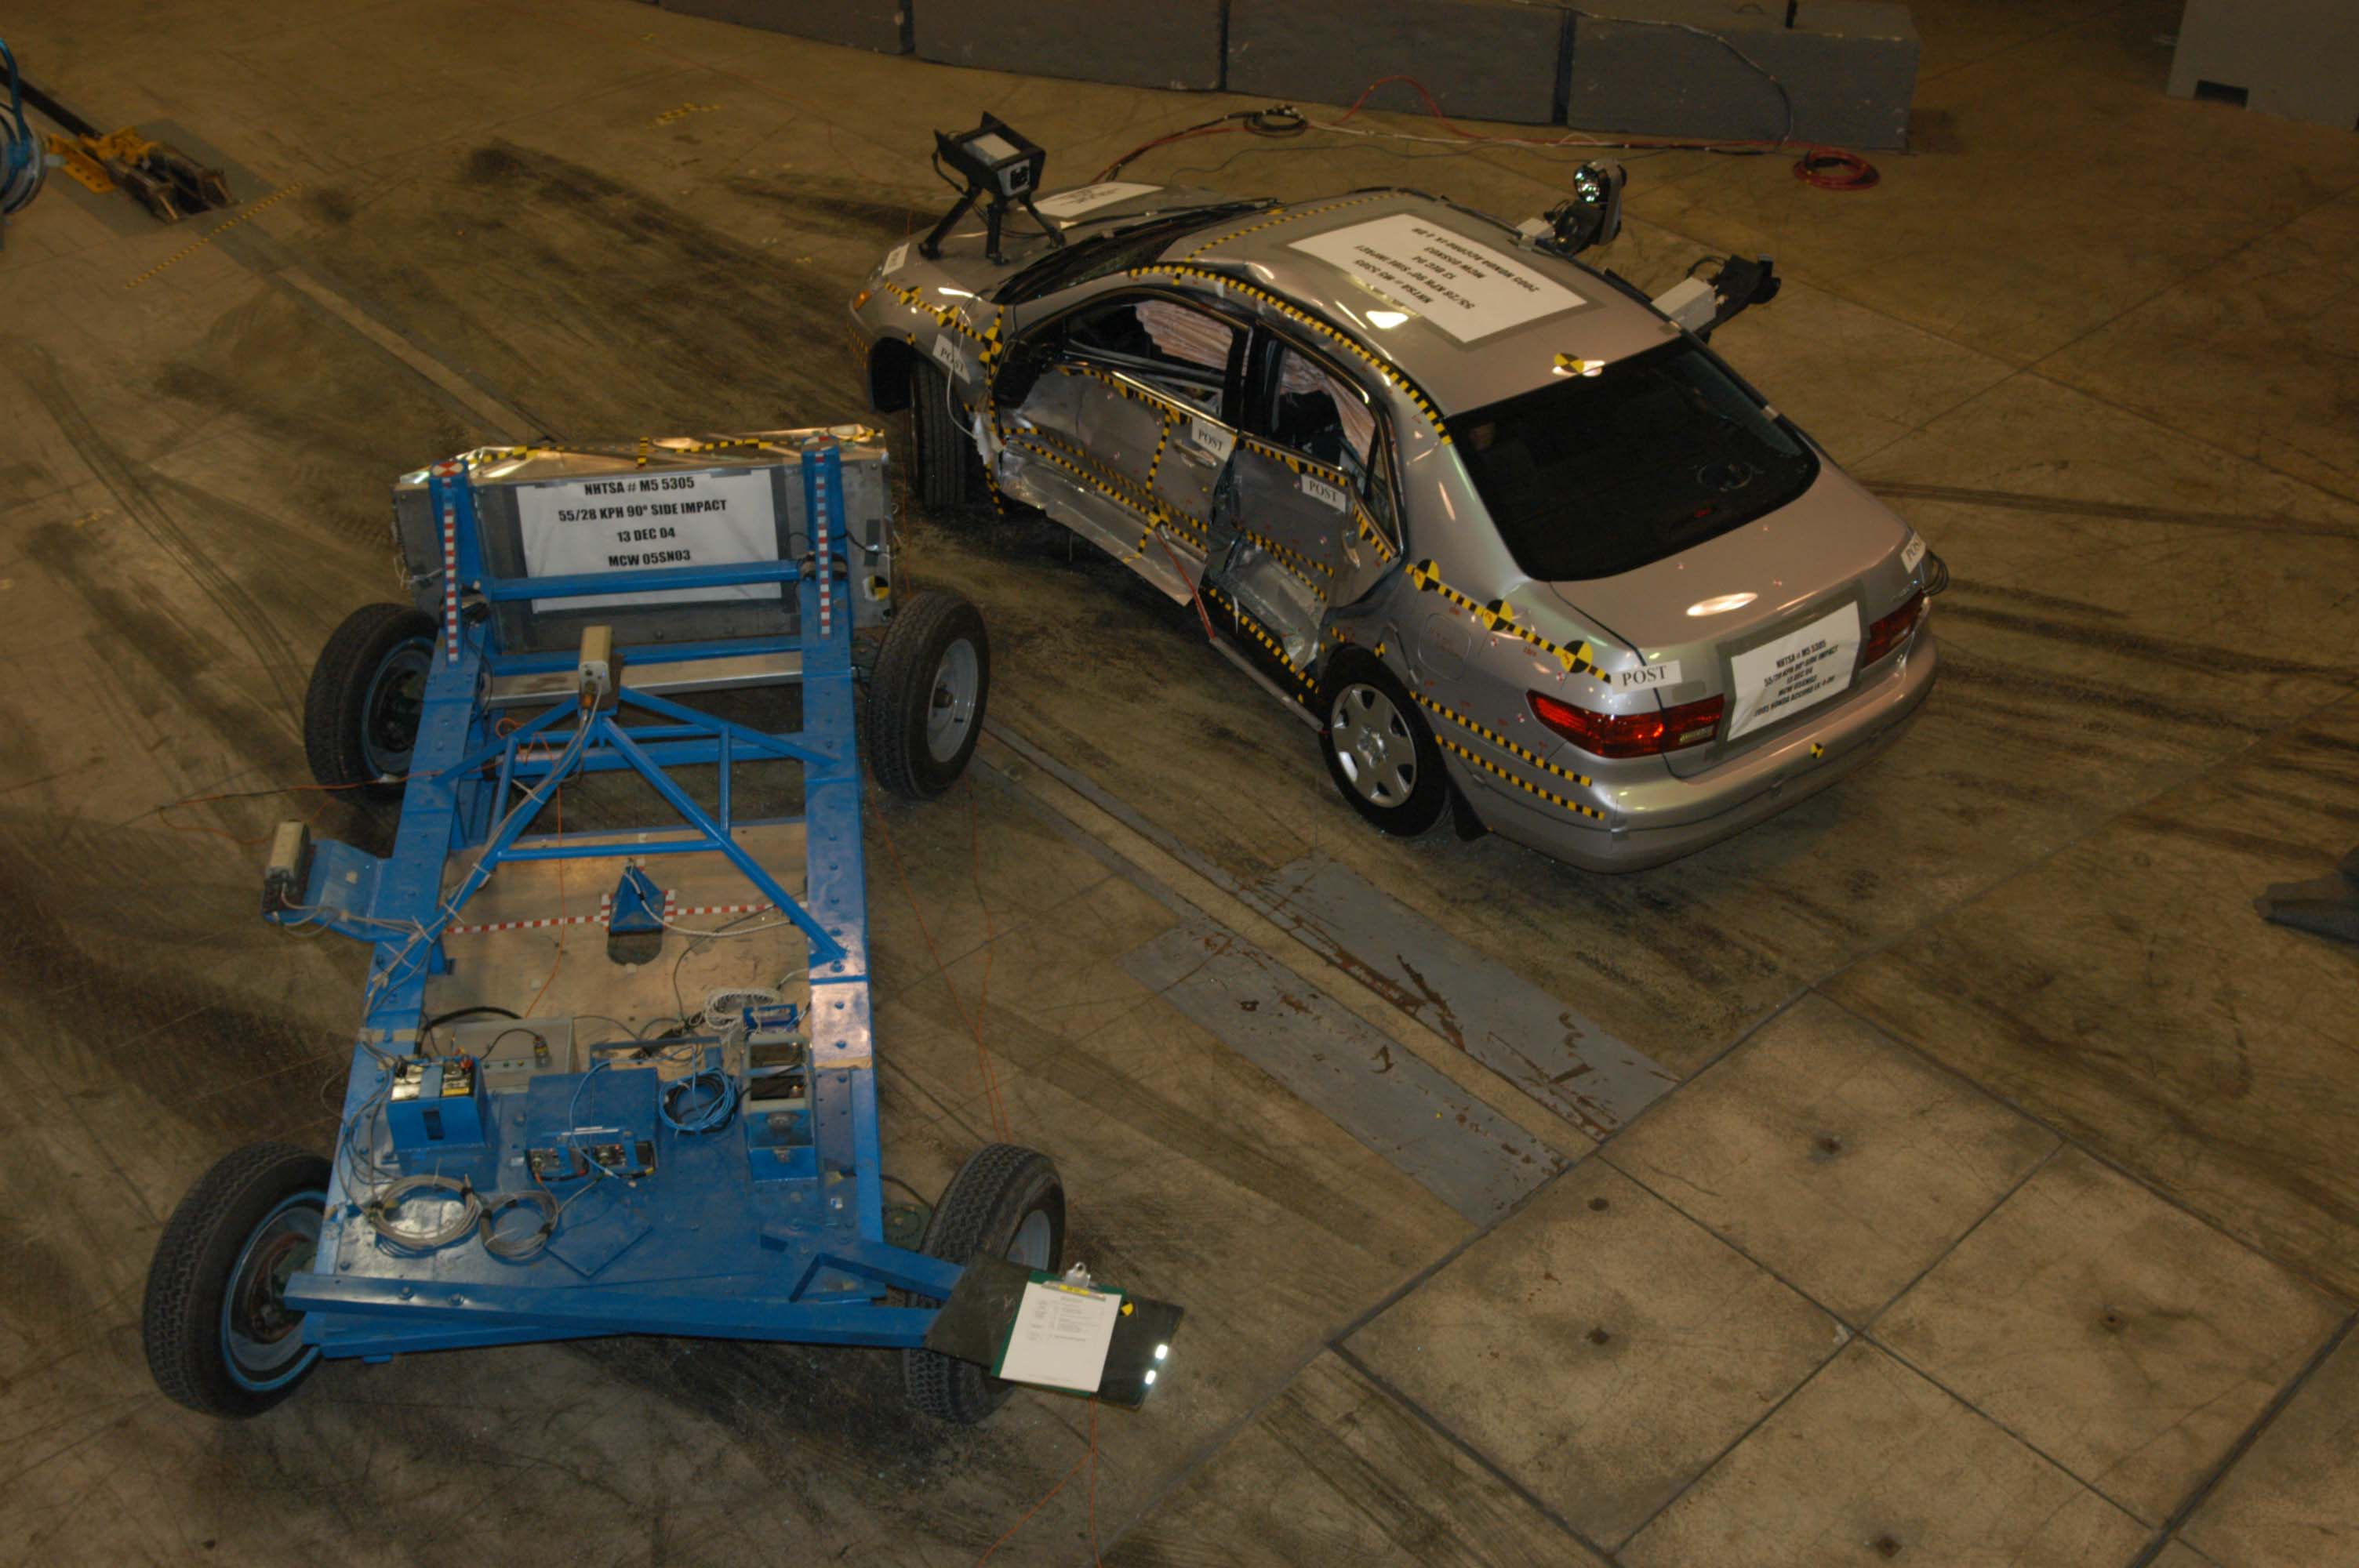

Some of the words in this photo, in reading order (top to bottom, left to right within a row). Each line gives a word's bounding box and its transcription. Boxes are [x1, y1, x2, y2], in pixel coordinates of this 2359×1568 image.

[1198, 428, 1224, 451] POST
[584, 481, 625, 495] NHTSA
[627, 483, 637, 492] #
[639, 480, 659, 492] M5
[661, 477, 695, 490] 5305
[1309, 480, 1338, 503] POST
[558, 508, 597, 522] 55/28
[600, 507, 624, 521] KPH
[651, 503, 678, 516] SIDE
[681, 499, 727, 514] IMPACT
[616, 530, 631, 543] 13
[634, 528, 657, 541] DEC
[660, 526, 676, 539] 04
[608, 554, 640, 568] MCW
[642, 550, 692, 565] 05SN03
[1622, 666, 1667, 687] POST
